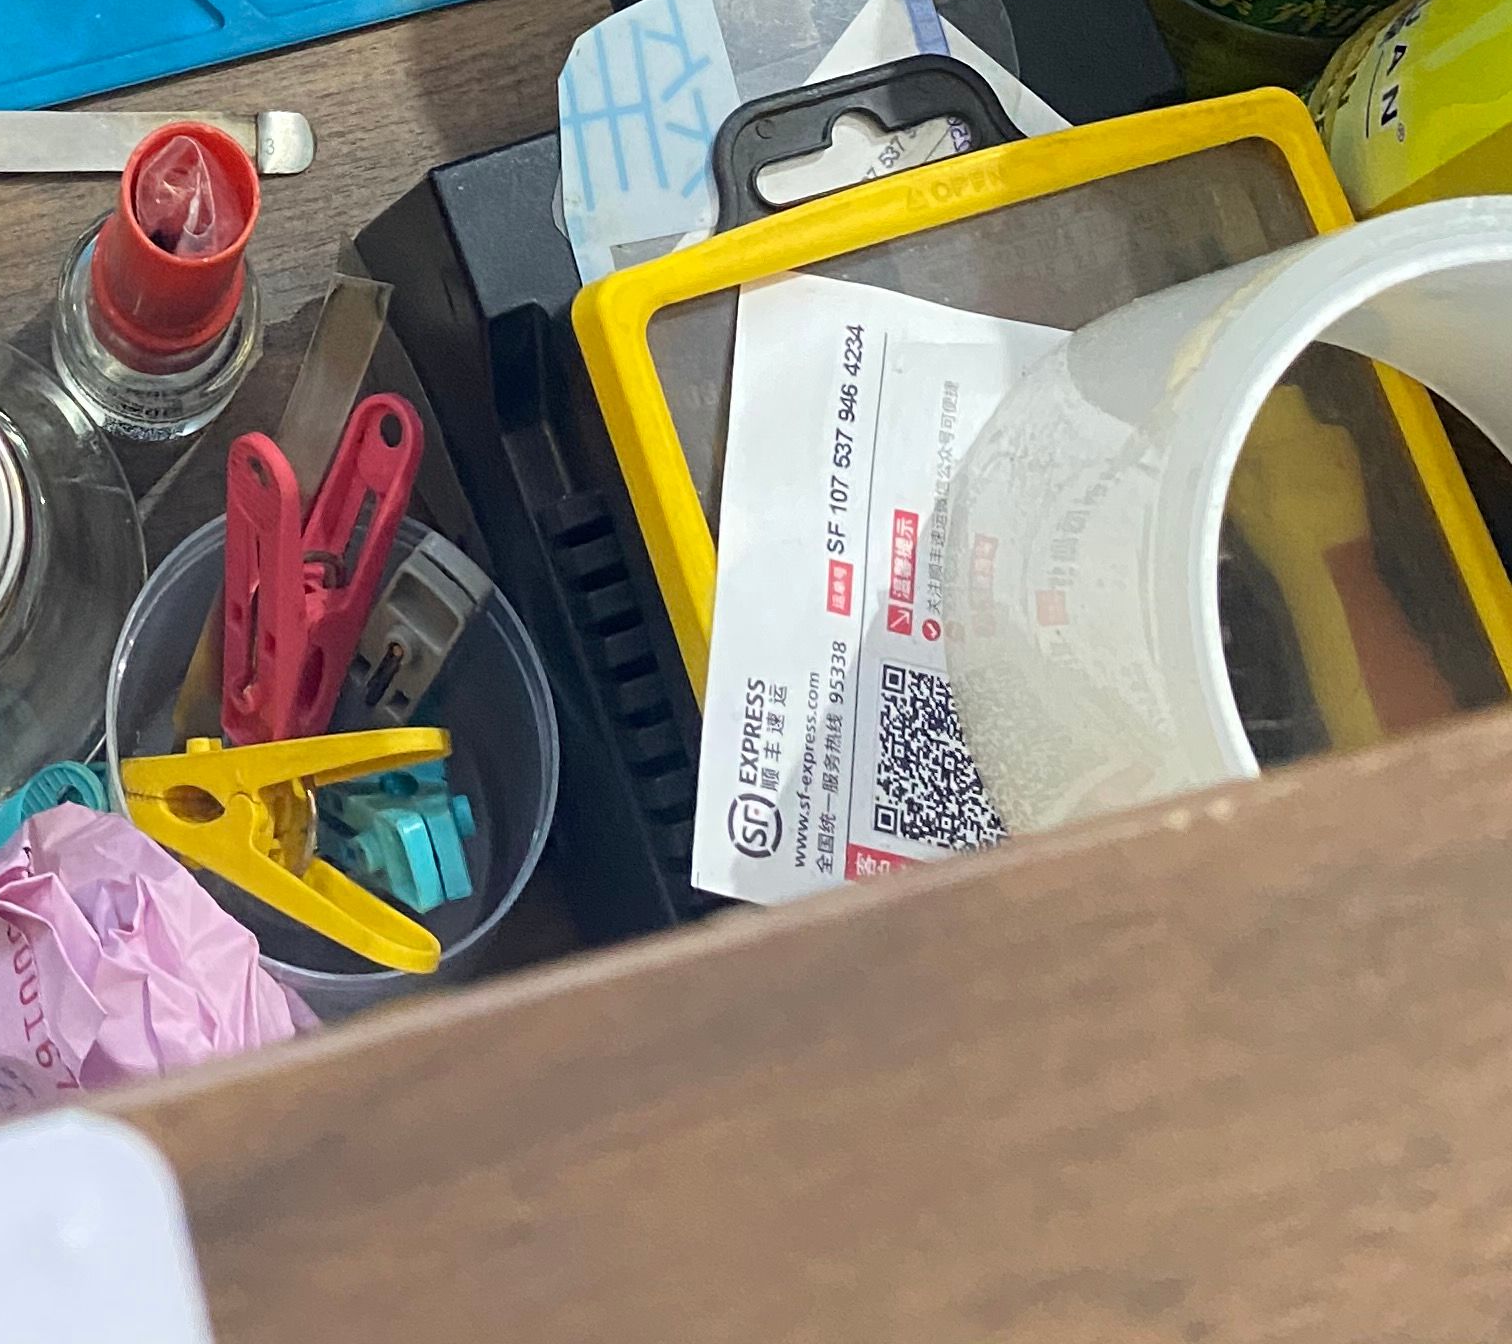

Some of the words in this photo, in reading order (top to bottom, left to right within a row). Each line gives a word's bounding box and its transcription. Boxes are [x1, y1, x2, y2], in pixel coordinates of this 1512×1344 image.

[846, 324, 865, 377] 4234
[838, 383, 858, 423] 946
[832, 427, 854, 469] 537
[828, 474, 849, 516] 107
[827, 521, 844, 555] SF
[893, 516, 916, 601] 温馨提示
[828, 640, 847, 705] 95338
[738, 677, 766, 787] EXPRESS
[760, 683, 787, 792] 顺丰速运
[794, 671, 820, 868] www.sf-express.com
[815, 713, 843, 875] 全国统一服务热线
